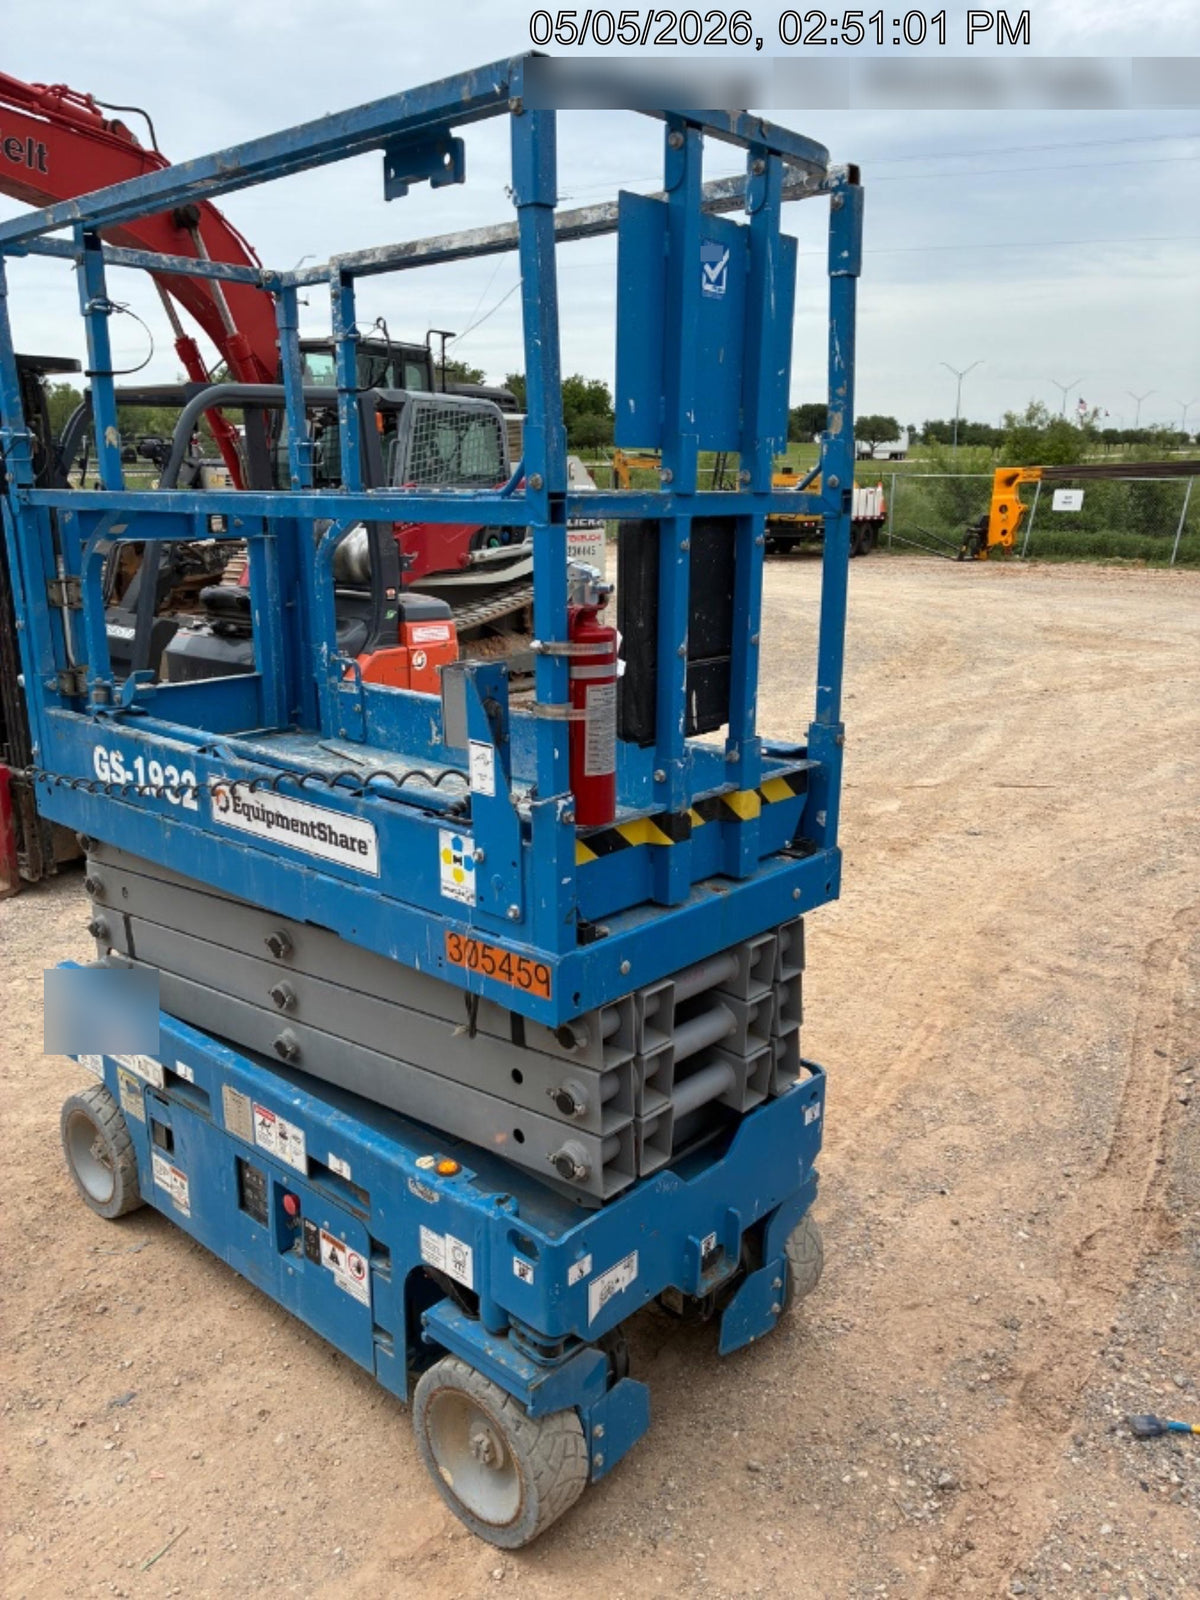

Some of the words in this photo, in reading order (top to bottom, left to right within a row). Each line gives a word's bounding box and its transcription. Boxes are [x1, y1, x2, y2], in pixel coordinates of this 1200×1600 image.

[0, 134, 48, 174] elt
[93, 744, 198, 811] GS-1932
[232, 795, 369, 856] EquipmentShare
[448, 932, 550, 998] 305459
